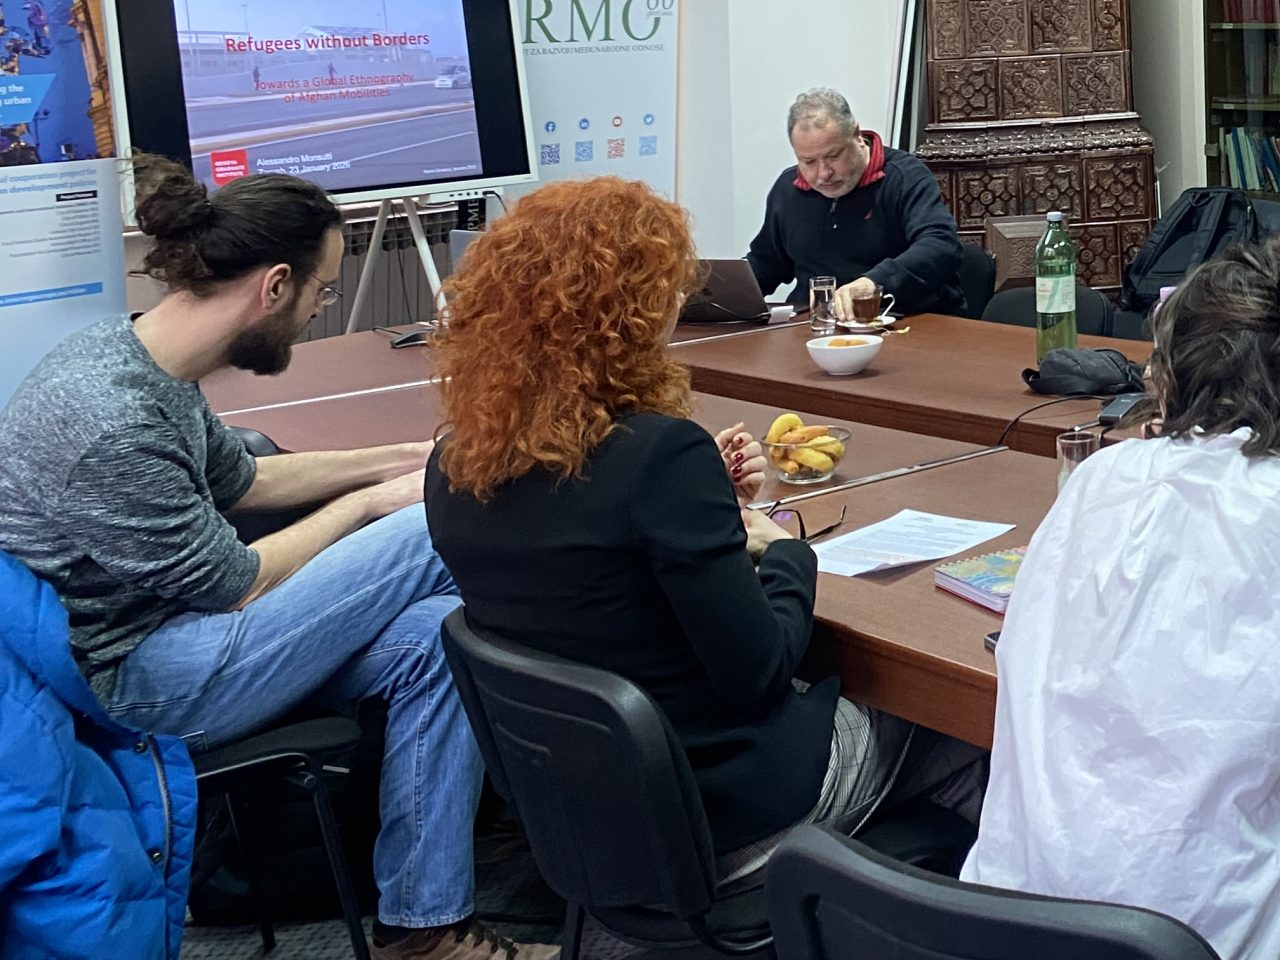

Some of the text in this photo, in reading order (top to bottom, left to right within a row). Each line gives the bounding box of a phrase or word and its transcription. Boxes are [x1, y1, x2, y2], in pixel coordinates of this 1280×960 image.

[226, 32, 430, 54] Refugees without Borders
[8, 84, 24, 92] the
[255, 77, 299, 90] Towards
[312, 76, 347, 88] Global
[350, 73, 414, 86] Ethnography
[4, 96, 32, 105] urban
[284, 87, 391, 104] of Afghan Mobilities
[256, 156, 300, 166] Alessandro
